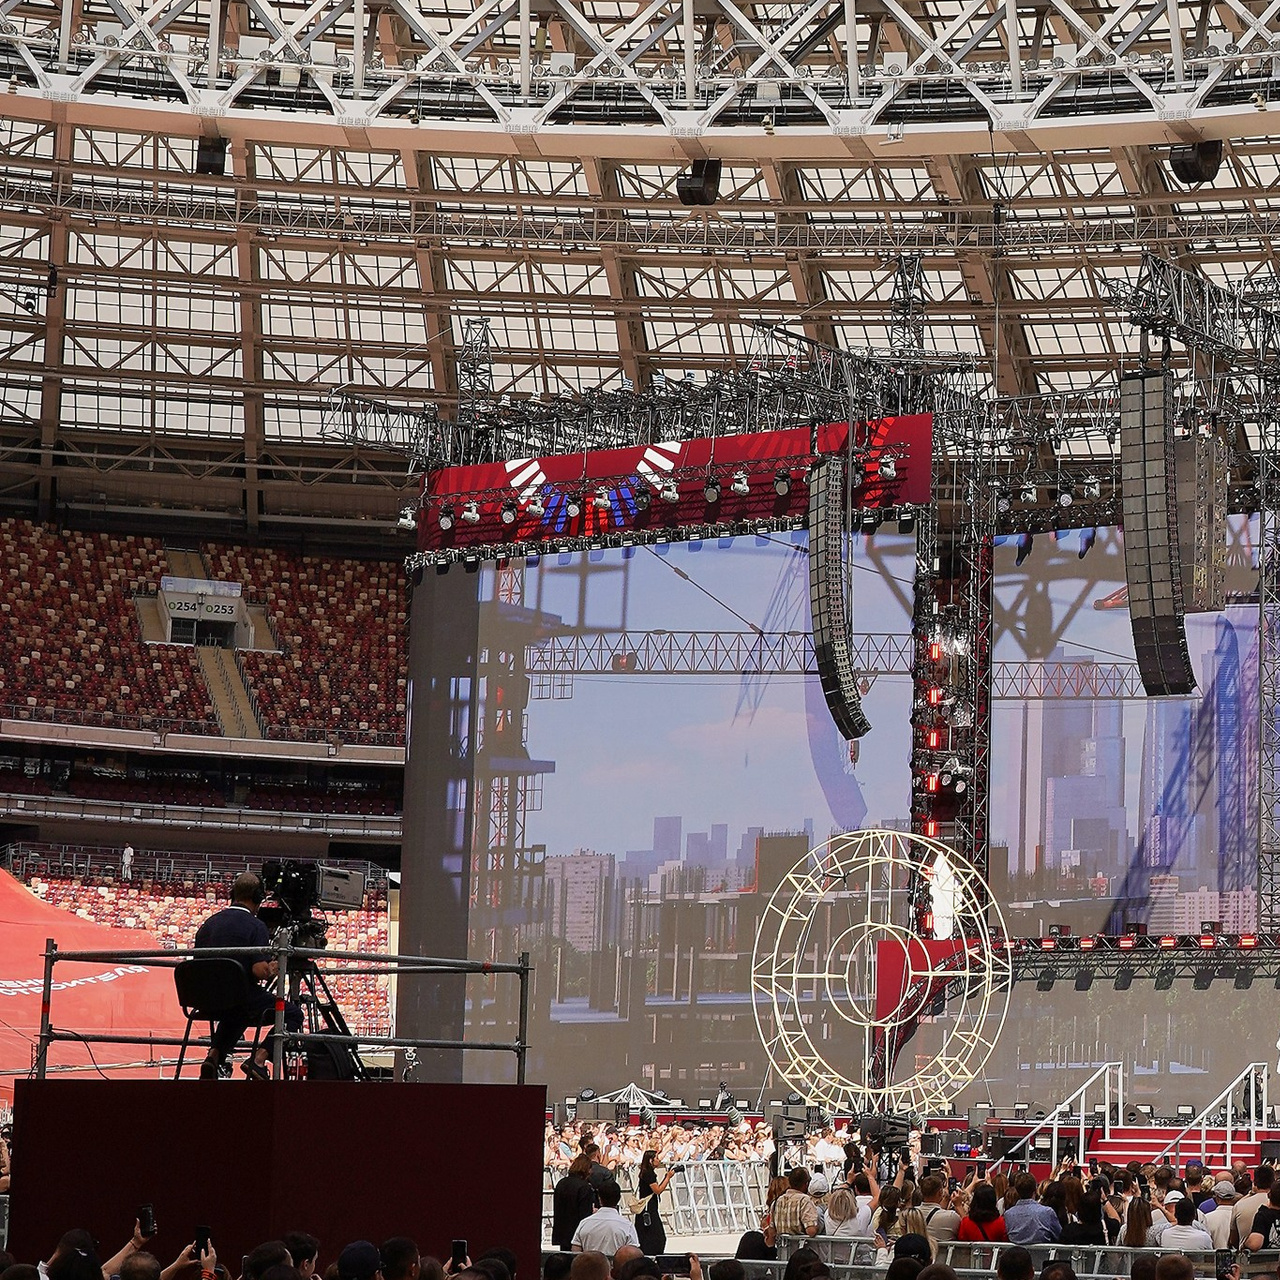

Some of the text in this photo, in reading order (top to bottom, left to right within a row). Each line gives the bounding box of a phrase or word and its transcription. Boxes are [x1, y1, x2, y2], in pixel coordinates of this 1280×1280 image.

[176, 601, 197, 612] 254
[213, 604, 234, 615] 253
[0, 979, 55, 988] ЕНЬ
